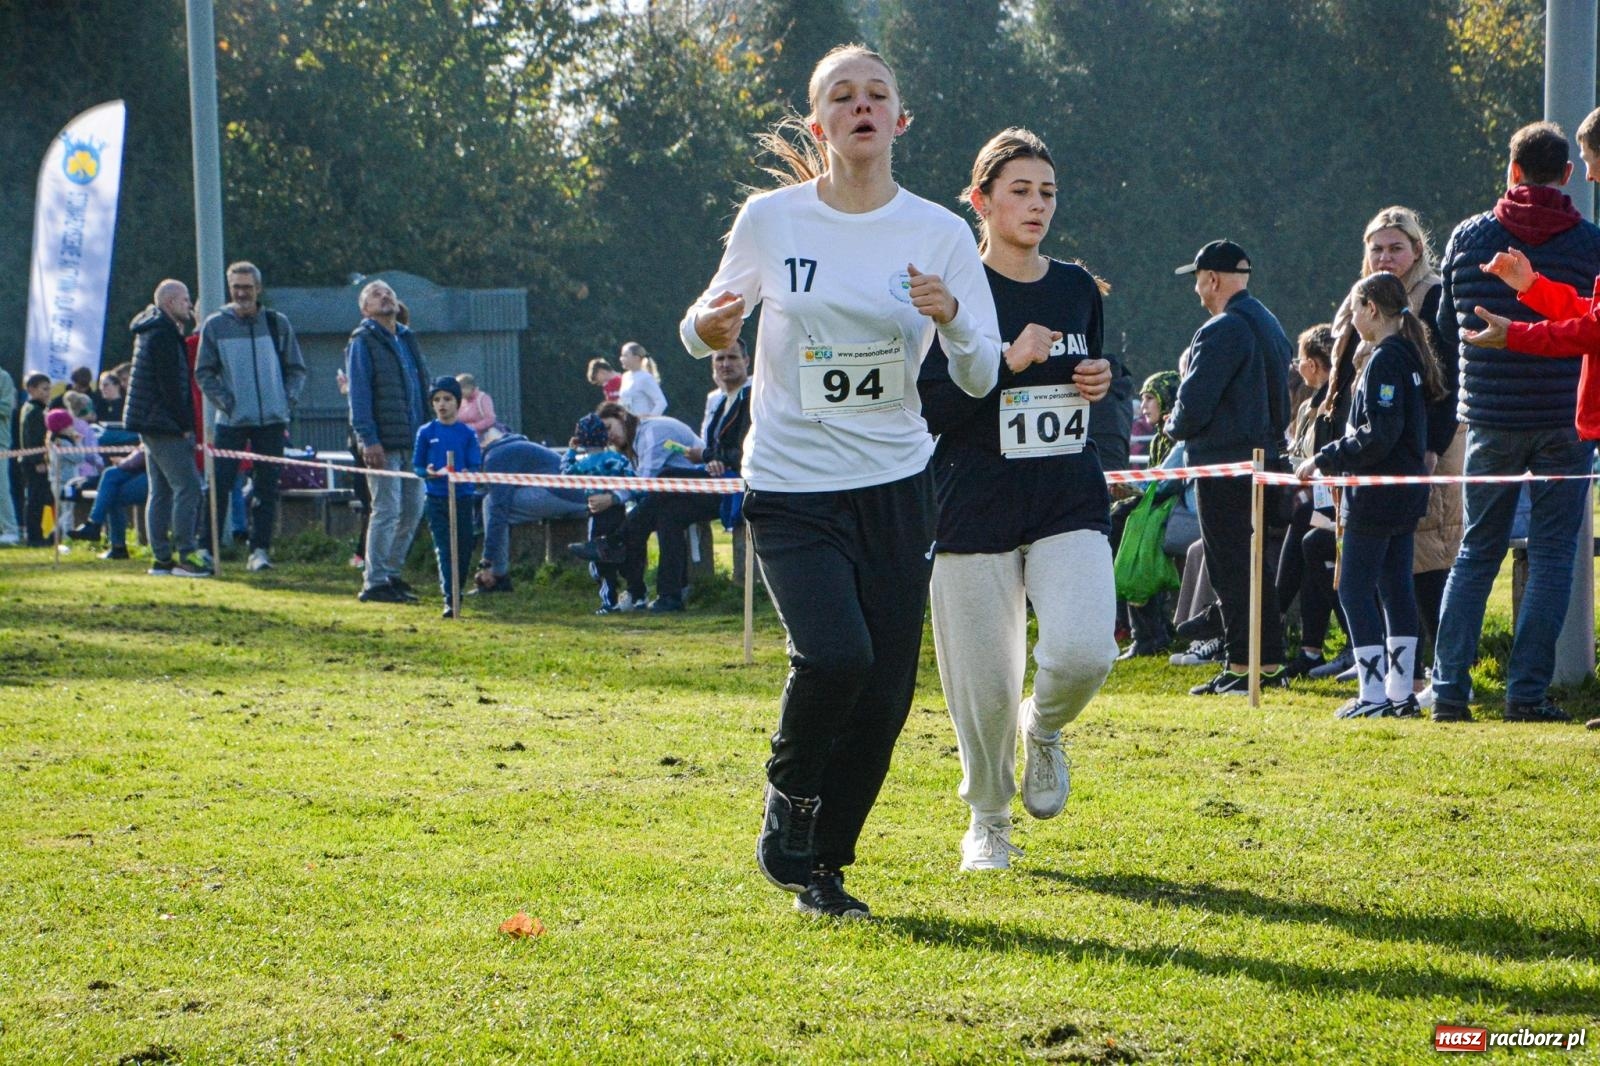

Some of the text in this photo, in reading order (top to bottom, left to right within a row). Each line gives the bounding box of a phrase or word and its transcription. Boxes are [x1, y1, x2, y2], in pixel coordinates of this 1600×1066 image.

[784, 257, 818, 293] 17
[837, 346, 901, 358] www.personalbest.pl
[823, 368, 884, 403] 94
[1007, 408, 1085, 445] 104
